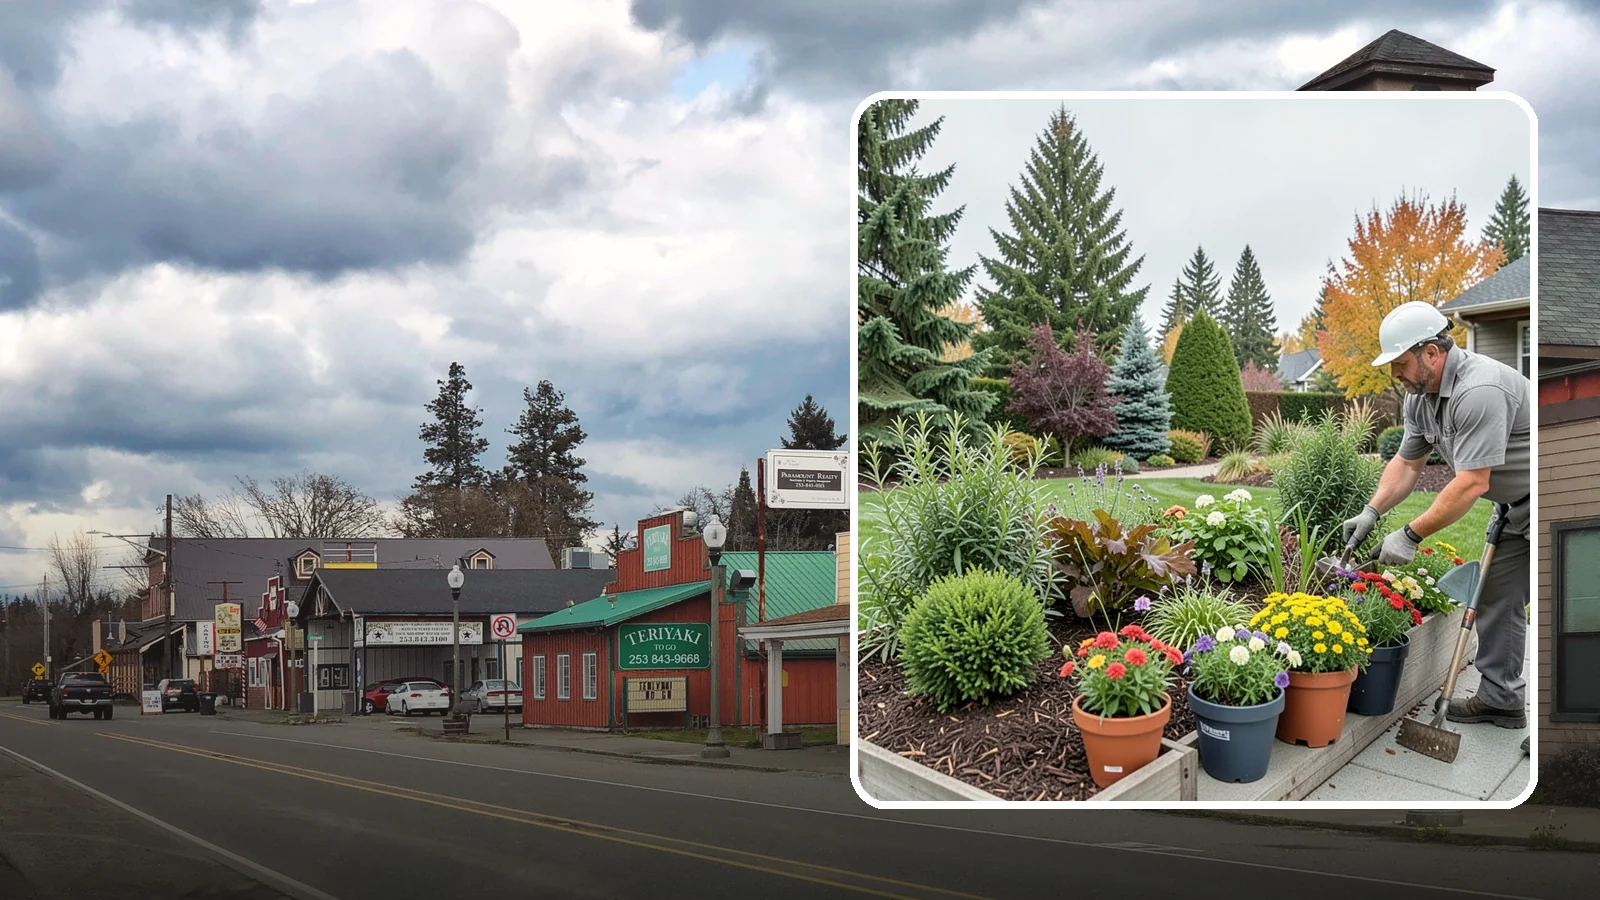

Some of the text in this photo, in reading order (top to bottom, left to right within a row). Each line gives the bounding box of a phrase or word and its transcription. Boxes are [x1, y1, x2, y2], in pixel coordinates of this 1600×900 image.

[781, 471, 815, 479] PARAMOUNT
[625, 627, 702, 646] TERIYAKI
[629, 653, 700, 664] 253 843-9668
[639, 681, 672, 690] TERIYAKI
